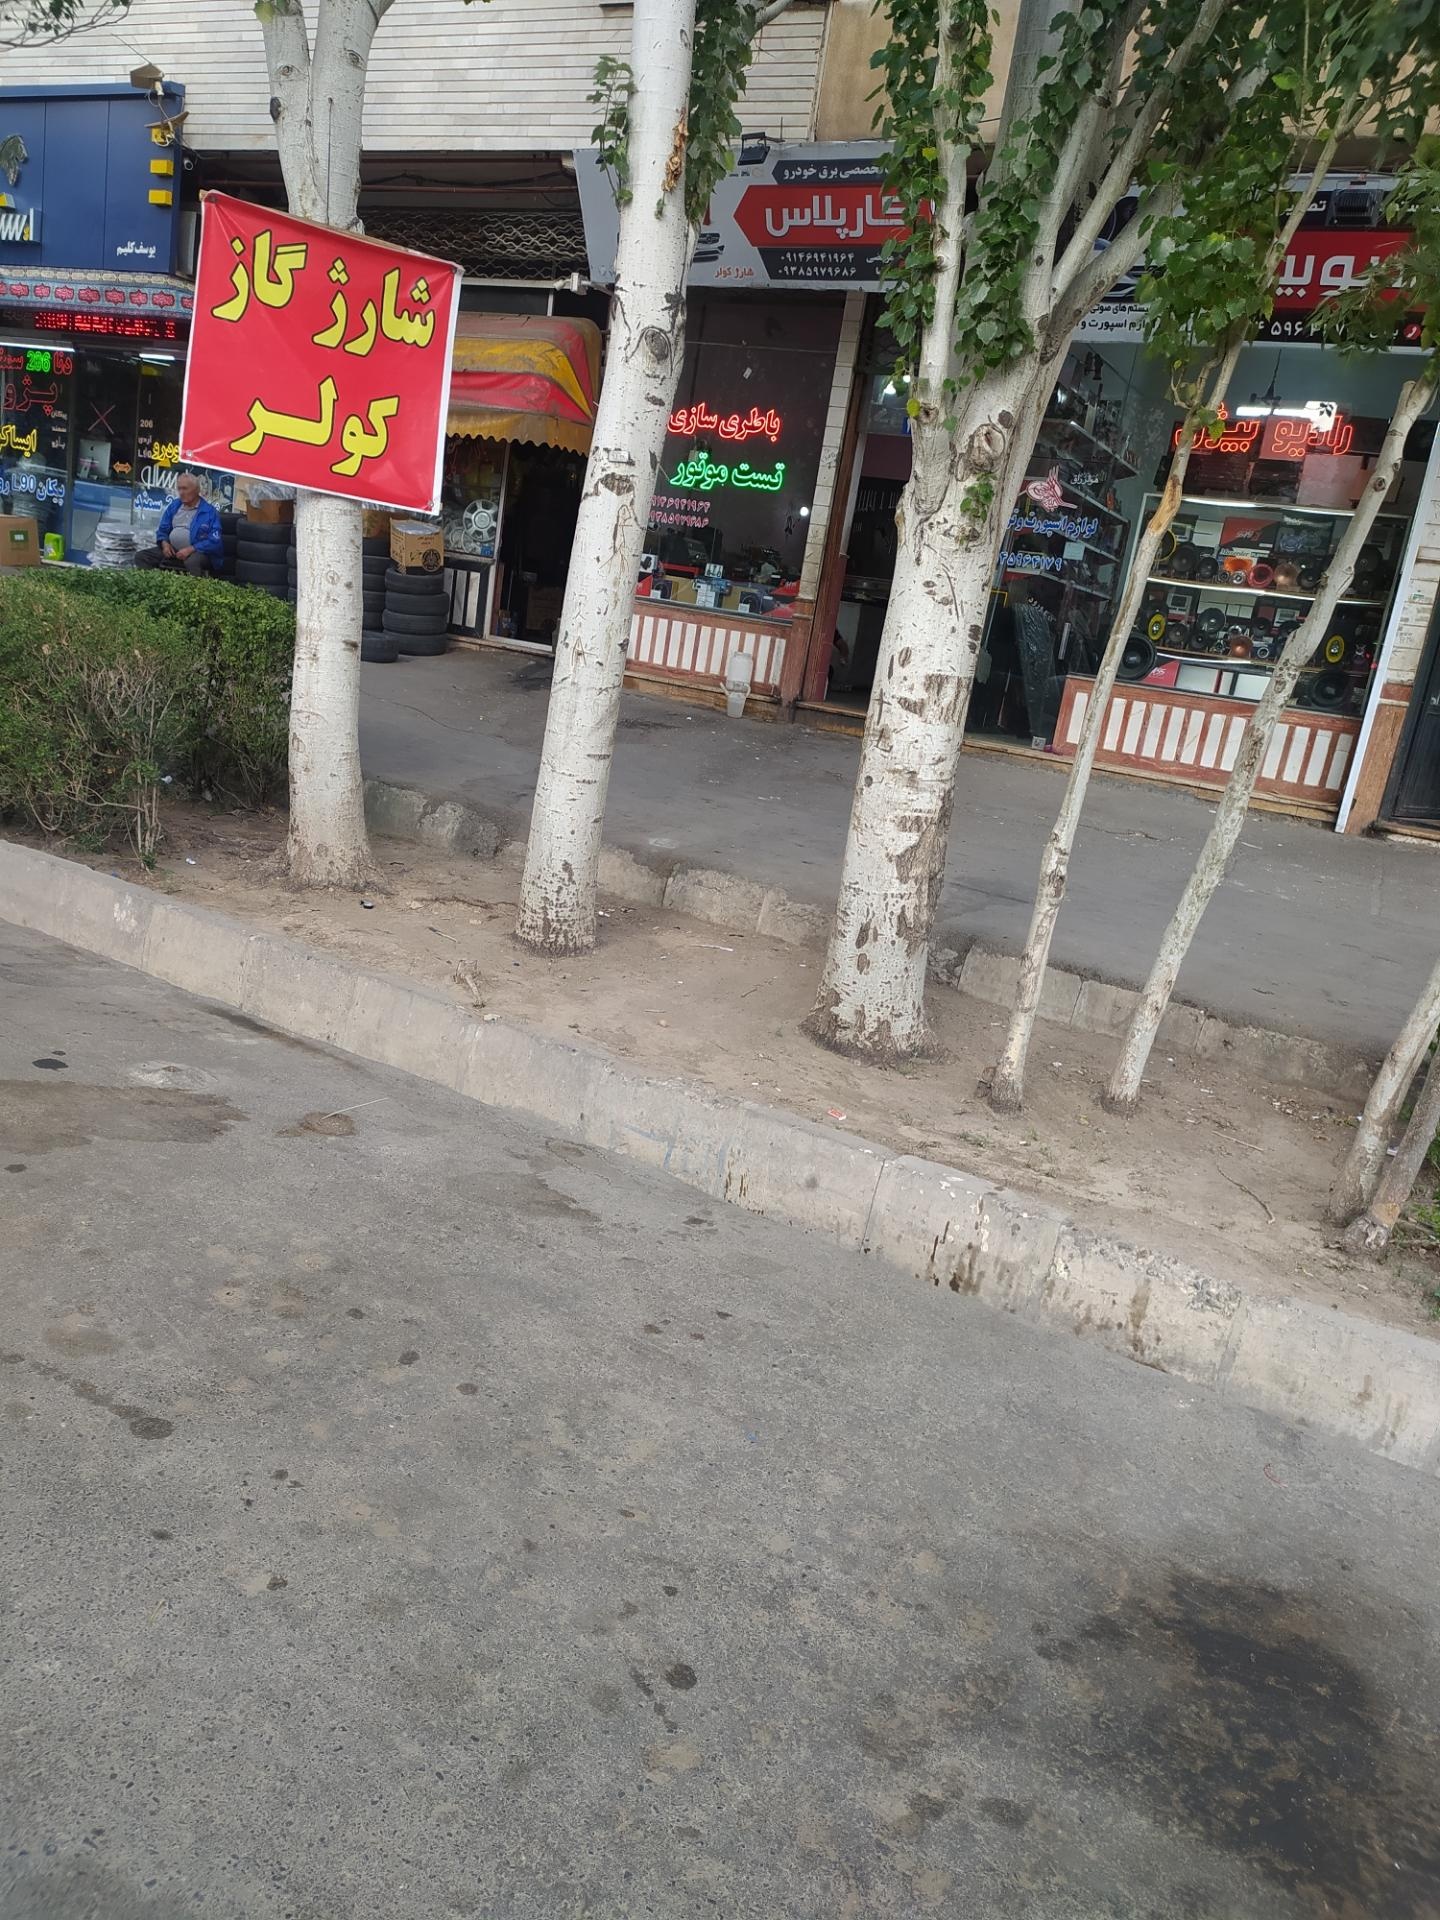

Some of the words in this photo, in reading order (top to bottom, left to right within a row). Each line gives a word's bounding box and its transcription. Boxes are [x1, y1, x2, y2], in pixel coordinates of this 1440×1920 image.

[783, 162, 817, 180] خودرو
[819, 165, 839, 180] برق
[211, 229, 309, 322] گاز
[714, 267, 732, 279] کولر
[735, 266, 754, 278] شارژ
[312, 257, 436, 357] شارژ
[1127, 304, 1150, 316] یستم
[1088, 319, 1127, 333] اسپورت
[139, 419, 154, 428] 206
[229, 375, 400, 478] کولر
[667, 402, 718, 435] سازی
[718, 408, 781, 442] باطری
[0, 425, 37, 458] ایساک
[1271, 414, 1354, 457] رادیو
[11, 473, 36, 493] L90
[669, 452, 729, 489] موتور
[731, 462, 785, 490] تست
[36, 477, 65, 506] پیکان
[1025, 511, 1068, 538] اسپورت
[1065, 516, 1099, 539] لوازم
